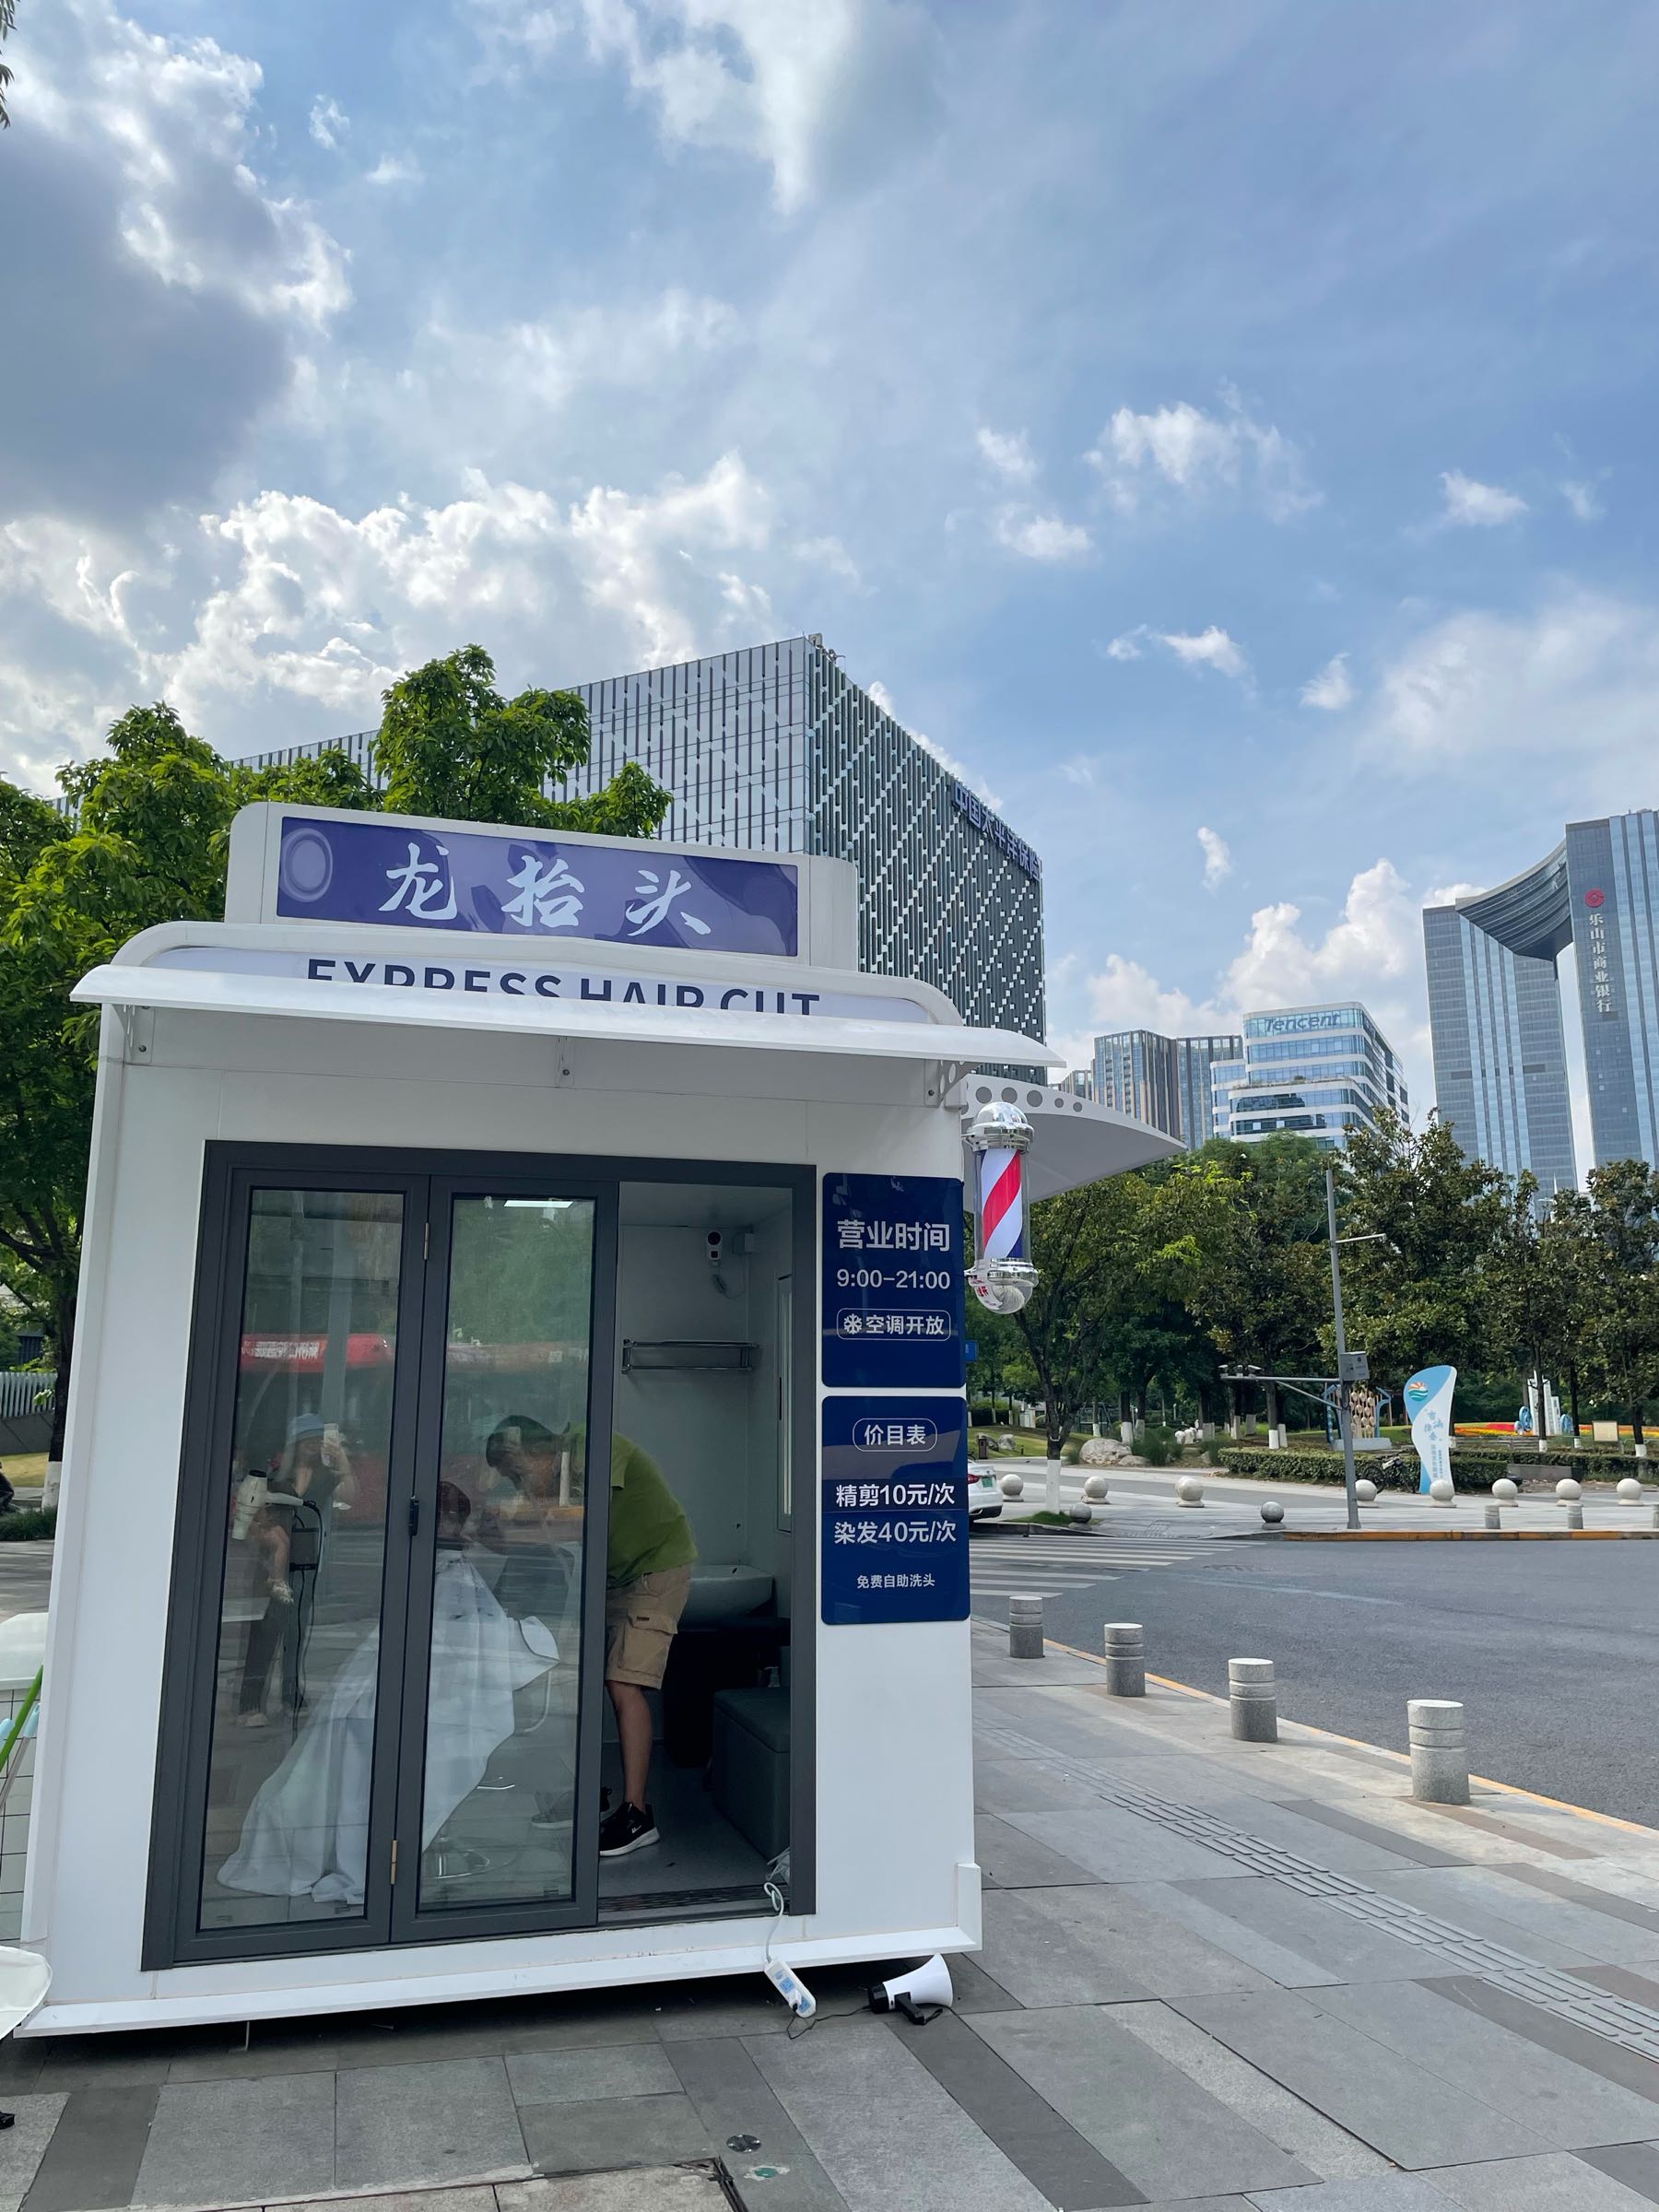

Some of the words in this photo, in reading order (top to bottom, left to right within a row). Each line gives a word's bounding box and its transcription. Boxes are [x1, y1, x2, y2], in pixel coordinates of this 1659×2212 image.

[378, 841, 712, 936] 龙抬头
[1589, 912, 1612, 1014] 乐山市商业银行
[1265, 1012, 1341, 1032] Tencent
[837, 1218, 950, 1252] 营业时间
[836, 1268, 951, 1289] 9:00-21:00
[865, 1314, 945, 1335] 空调开放
[864, 1424, 926, 1446] 价目表
[836, 1482, 956, 1508] 精剪10元/次
[834, 1520, 957, 1545] 染发40元/次
[856, 1573, 935, 1589] 免费自助洗头
